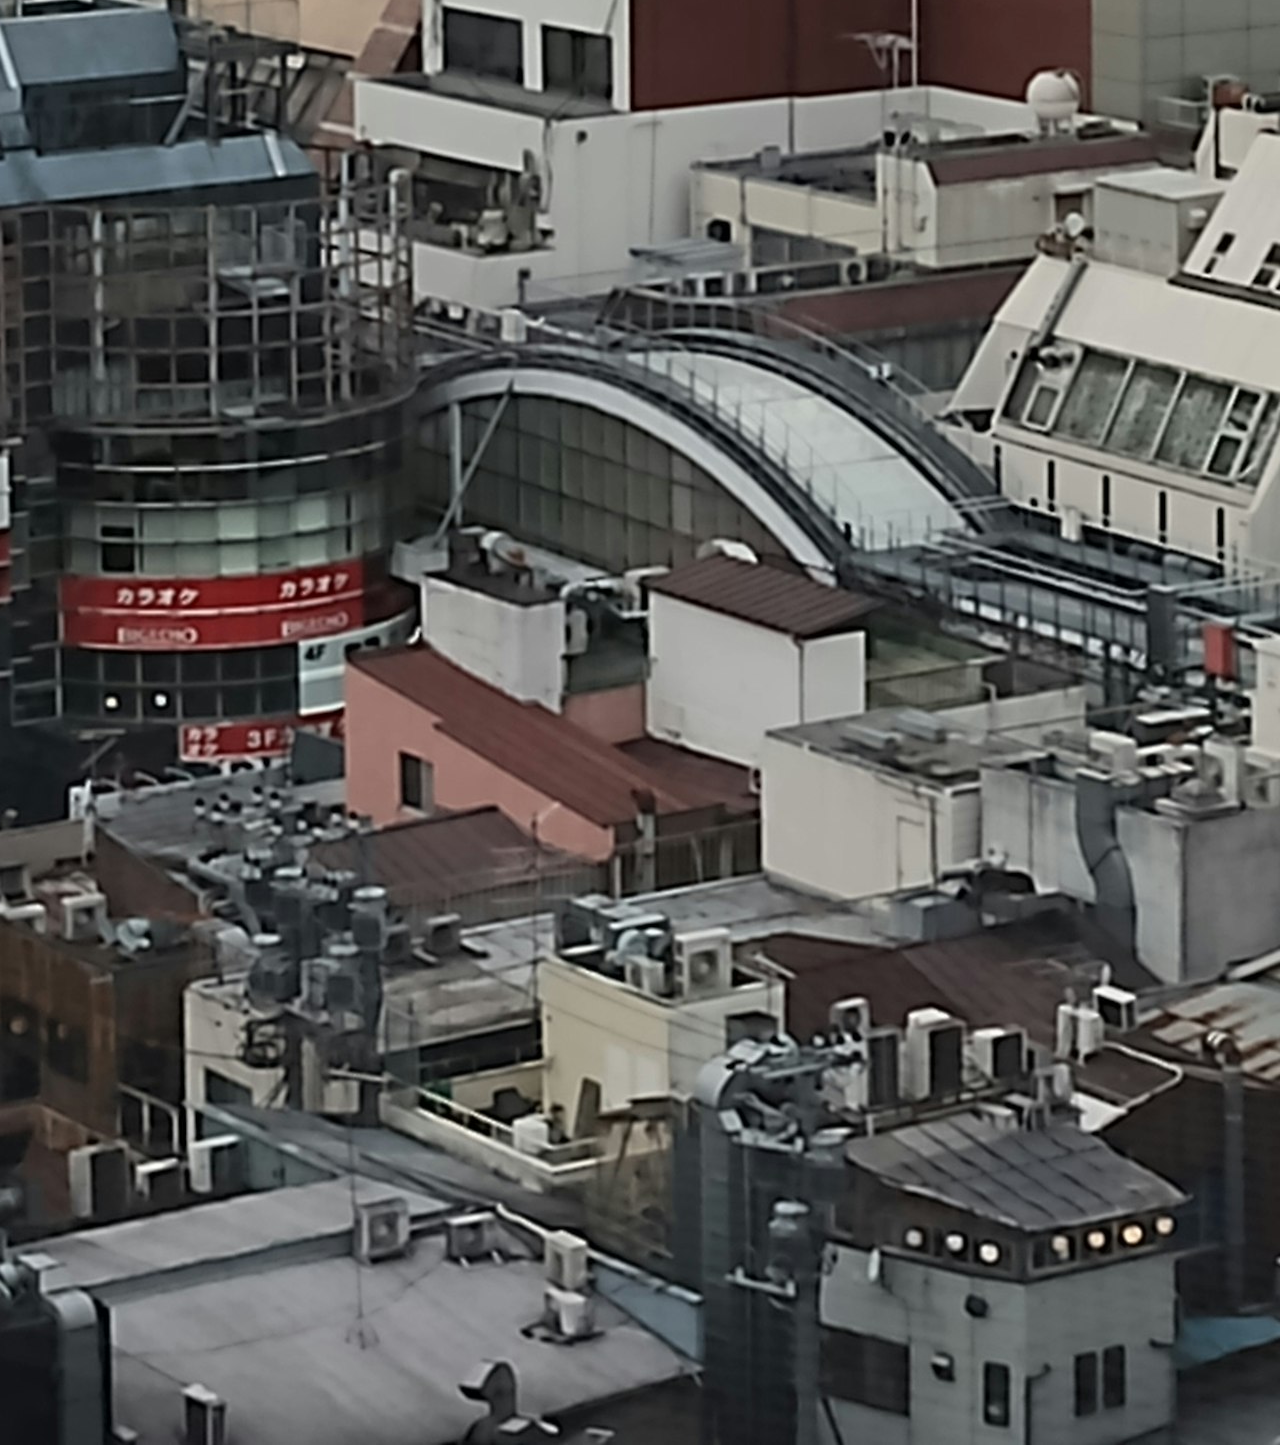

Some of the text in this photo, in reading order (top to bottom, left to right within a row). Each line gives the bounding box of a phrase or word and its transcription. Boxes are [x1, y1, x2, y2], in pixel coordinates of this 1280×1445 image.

[278, 572, 350, 600] カラオケ
[116, 587, 200, 606] カラオケ
[246, 728, 278, 748] 3F
